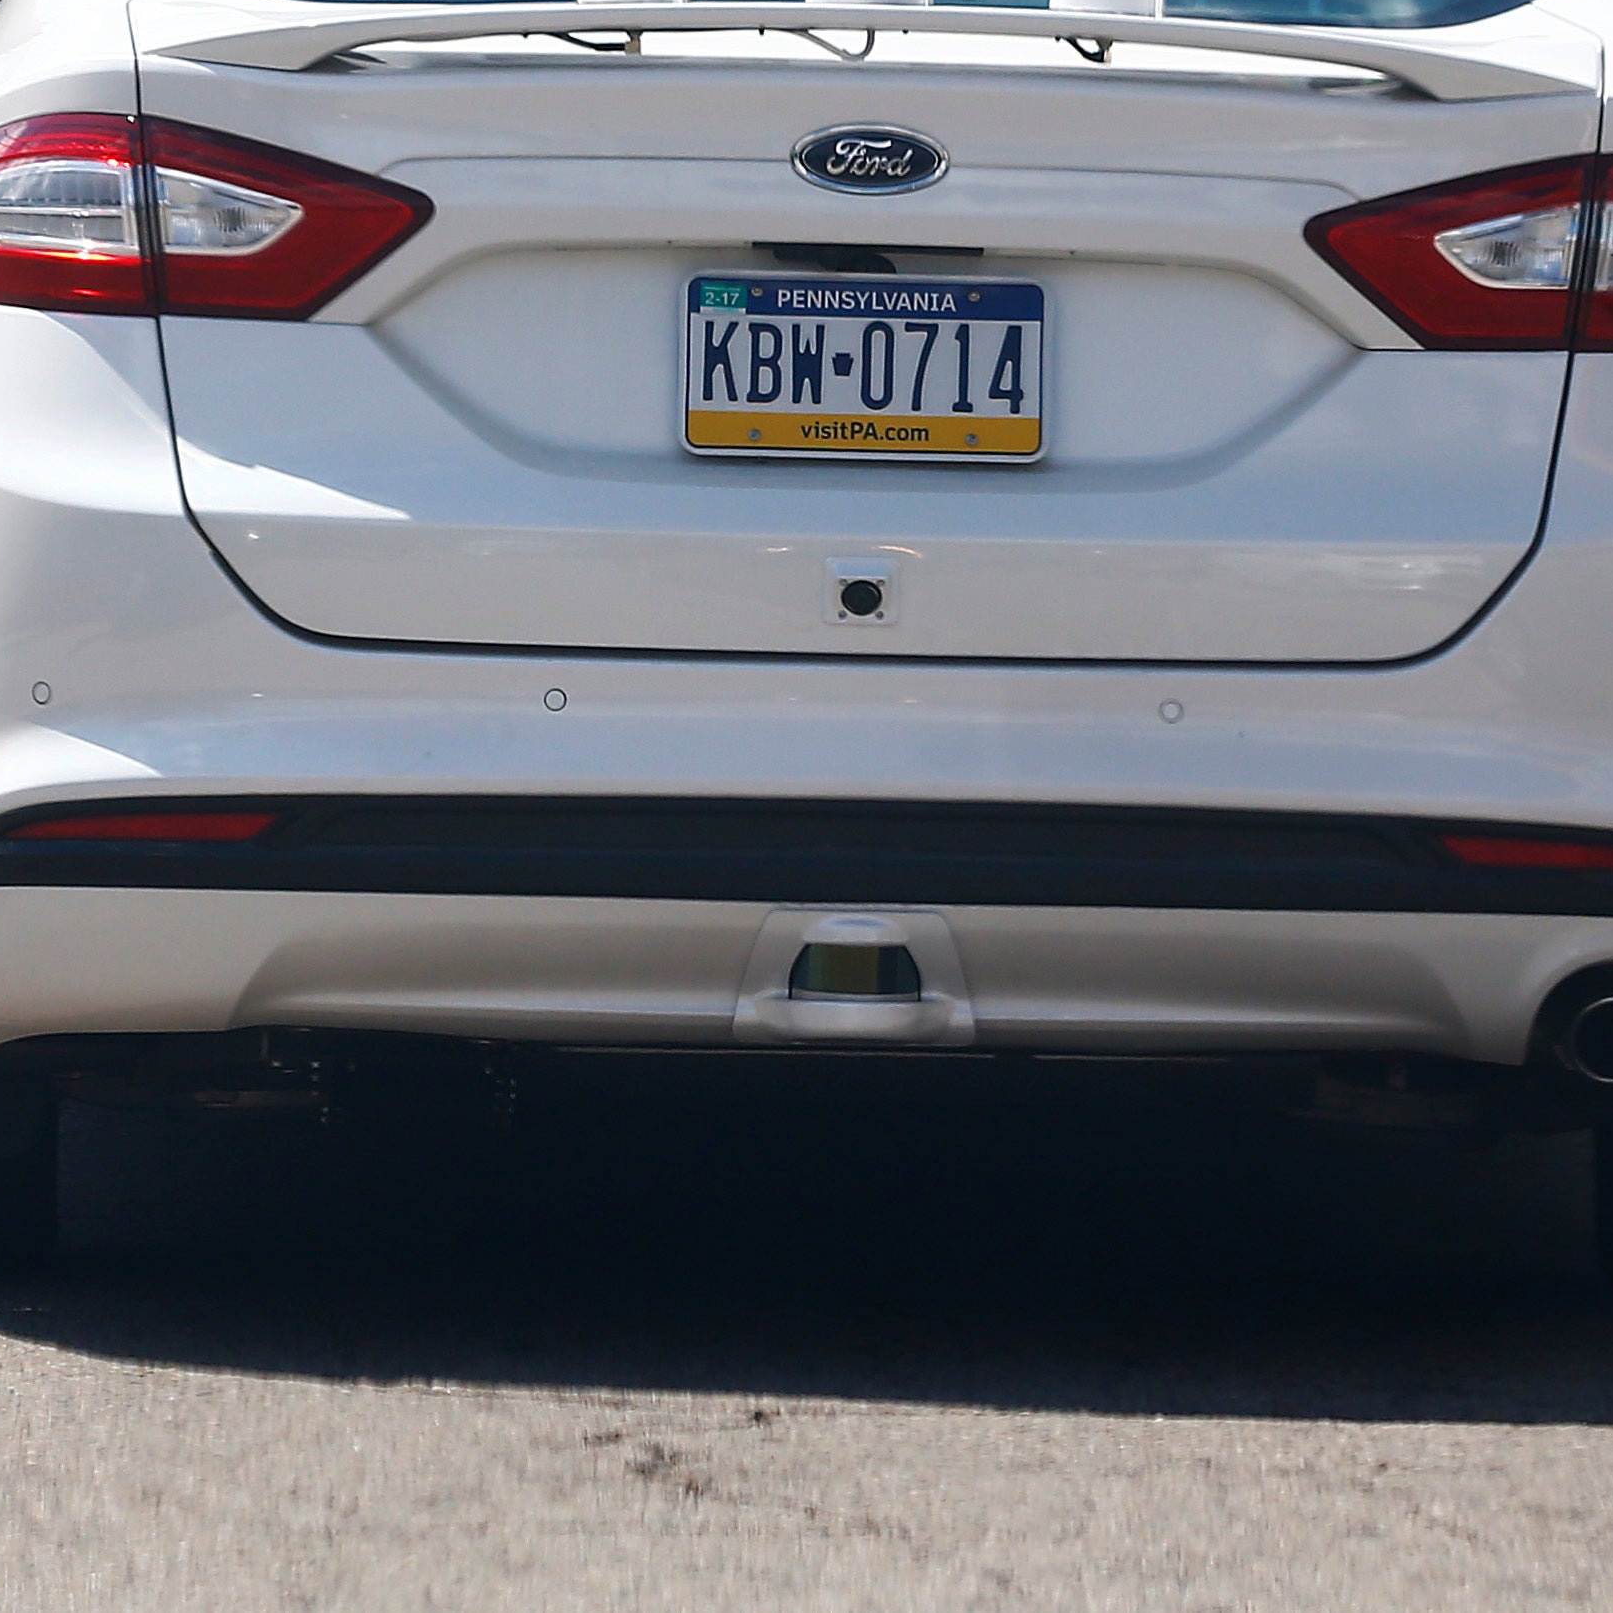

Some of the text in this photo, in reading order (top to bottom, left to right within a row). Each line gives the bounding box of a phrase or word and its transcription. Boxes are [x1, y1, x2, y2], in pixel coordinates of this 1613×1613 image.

[826, 138, 913, 177] Ford
[705, 291, 739, 306] 2-17
[777, 289, 957, 312] PENNSYLVANIA
[800, 421, 930, 442] visitPA.com
